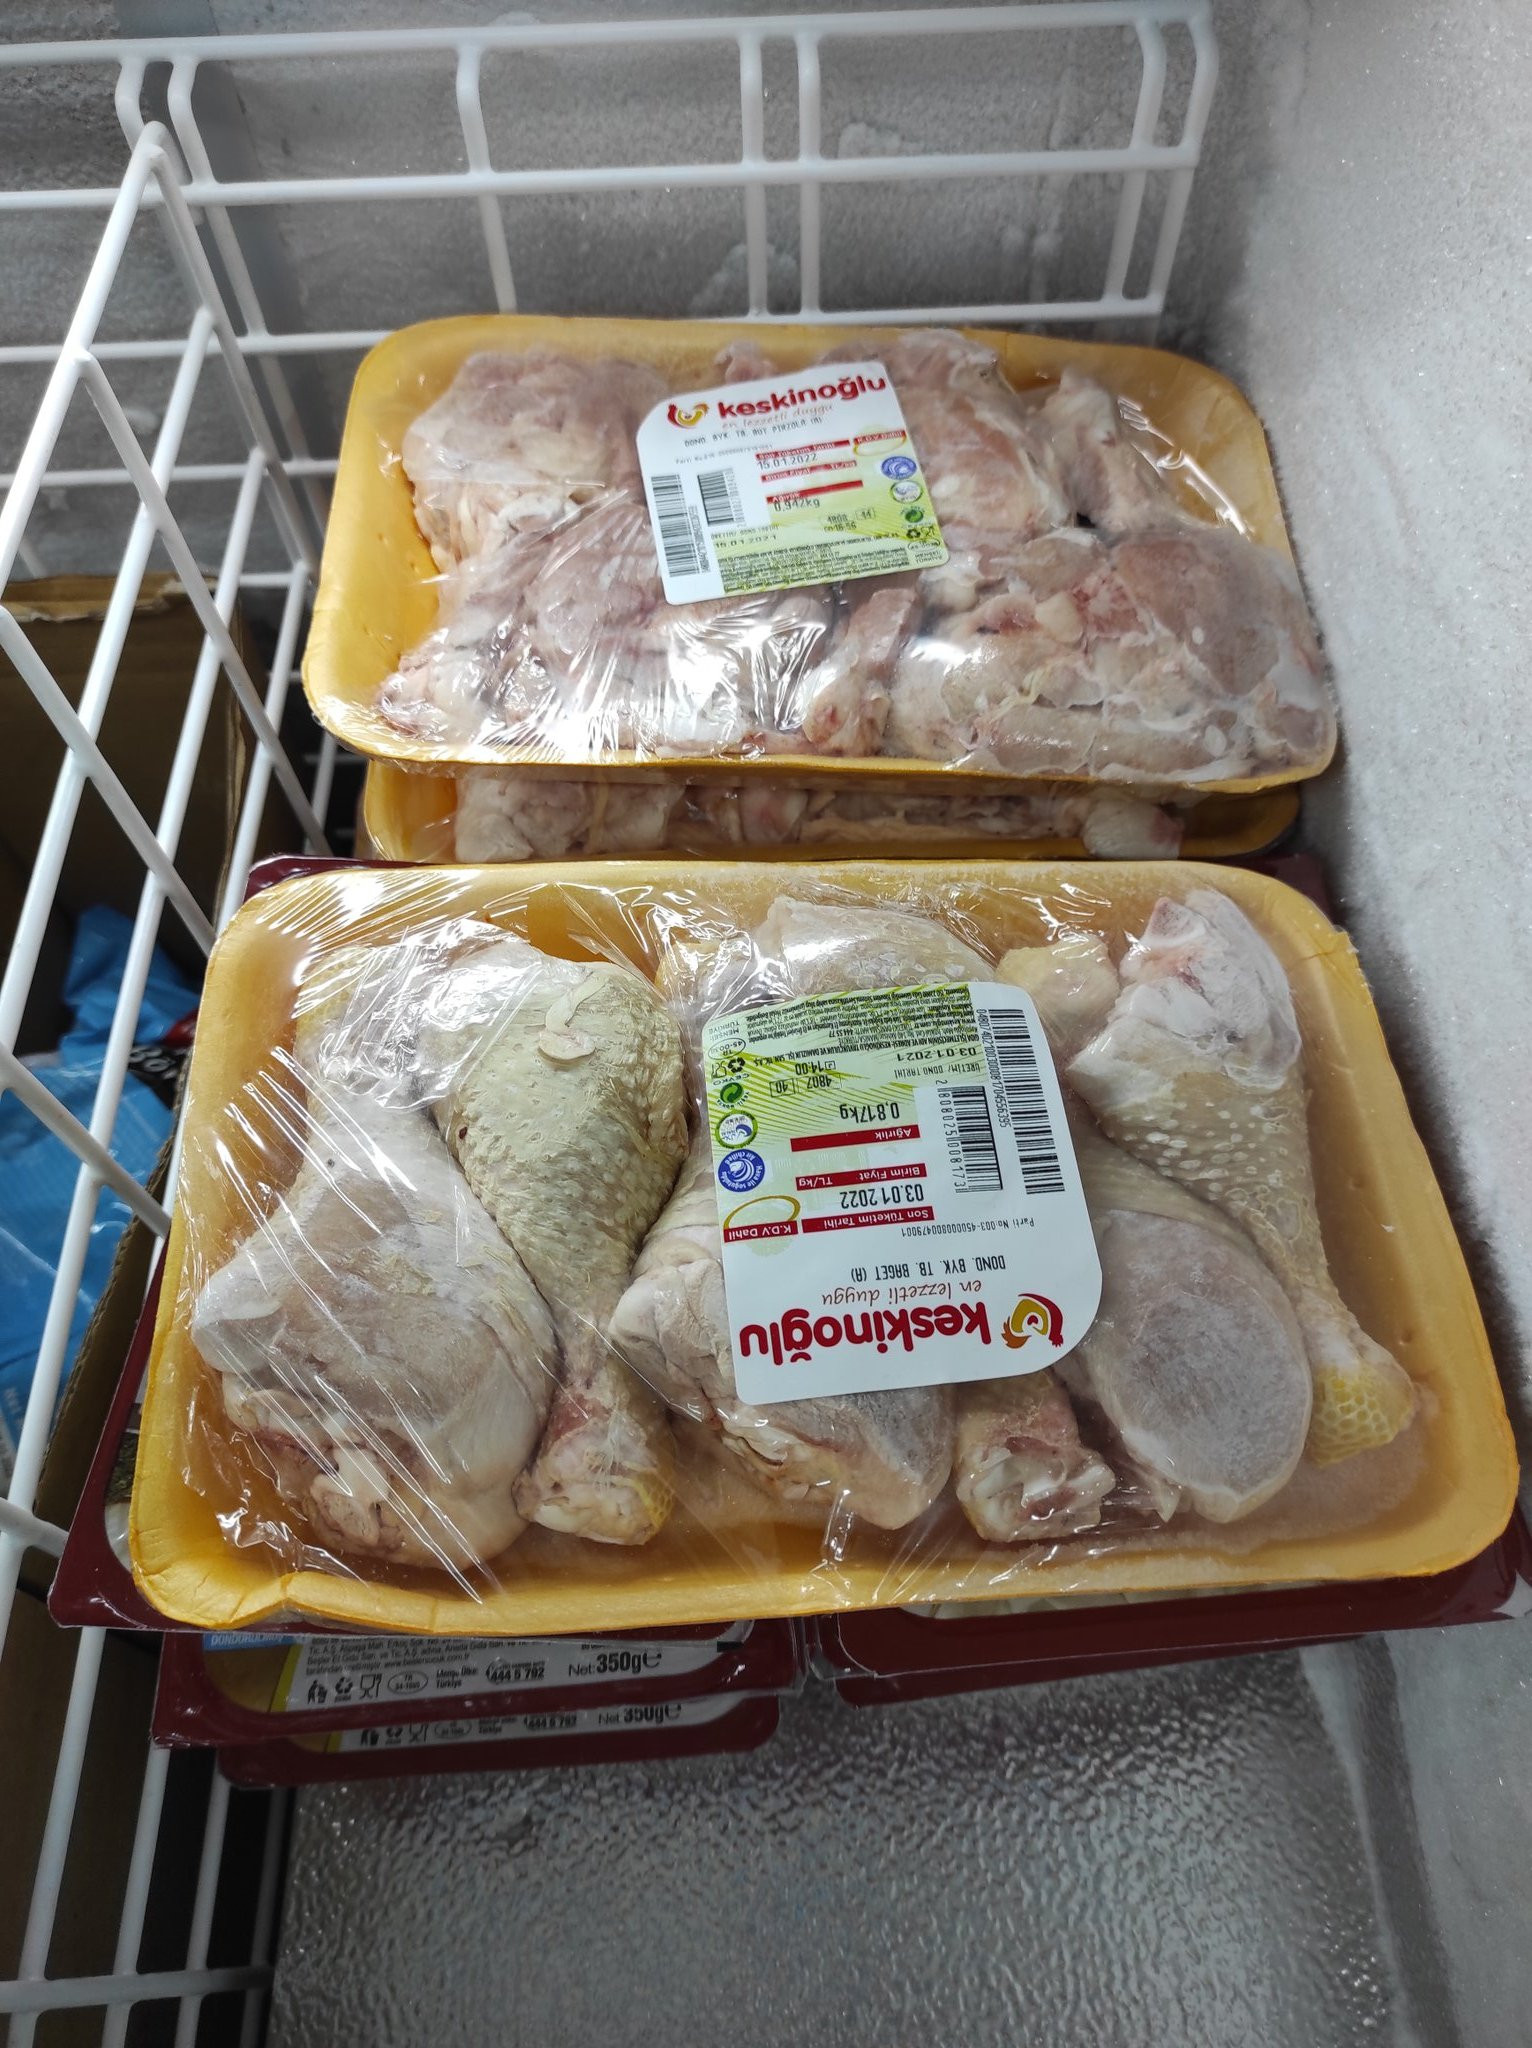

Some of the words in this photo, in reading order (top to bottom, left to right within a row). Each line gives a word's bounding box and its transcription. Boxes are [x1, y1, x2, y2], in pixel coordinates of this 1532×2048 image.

[718, 374, 886, 419] keskinoğlu
[828, 1030, 836, 1039] 77
[835, 1029, 844, 1038] 55
[843, 1028, 854, 1037] 444
[896, 1047, 977, 1062] 03.01.2021
[794, 1060, 825, 1076] 14:00
[775, 1080, 789, 1093] 40
[806, 1074, 832, 1089] 4807
[838, 1101, 900, 1123] 0,817kg
[874, 1127, 912, 1140] Ağırlık
[724, 1151, 746, 1165] chilled
[746, 1152, 756, 1162] Air
[753, 1164, 763, 1181] Hava
[858, 1168, 887, 1180] Fiyat
[890, 1166, 920, 1178] Birim
[798, 1176, 833, 1188] TL/kg
[857, 1211, 904, 1225] Tüketim
[907, 1209, 929, 1219] Son
[823, 1216, 855, 1229] Tarihi
[1012, 1217, 1034, 1229] Parti
[728, 1227, 758, 1240] Dahil
[761, 1224, 792, 1237] K.D.V
[915, 1261, 933, 1277] TB.
[939, 1258, 966, 1275] BYK.
[972, 1255, 1005, 1271] DOND.
[850, 1267, 867, 1282] (A)
[874, 1263, 910, 1281] BAGET
[888, 1281, 952, 1305] lezzetli
[959, 1279, 981, 1293] en
[821, 1286, 880, 1307] duygu
[739, 1302, 991, 1366] keskinoğlu
[491, 1669, 511, 1682] 444
[568, 1663, 595, 1677] Net:
